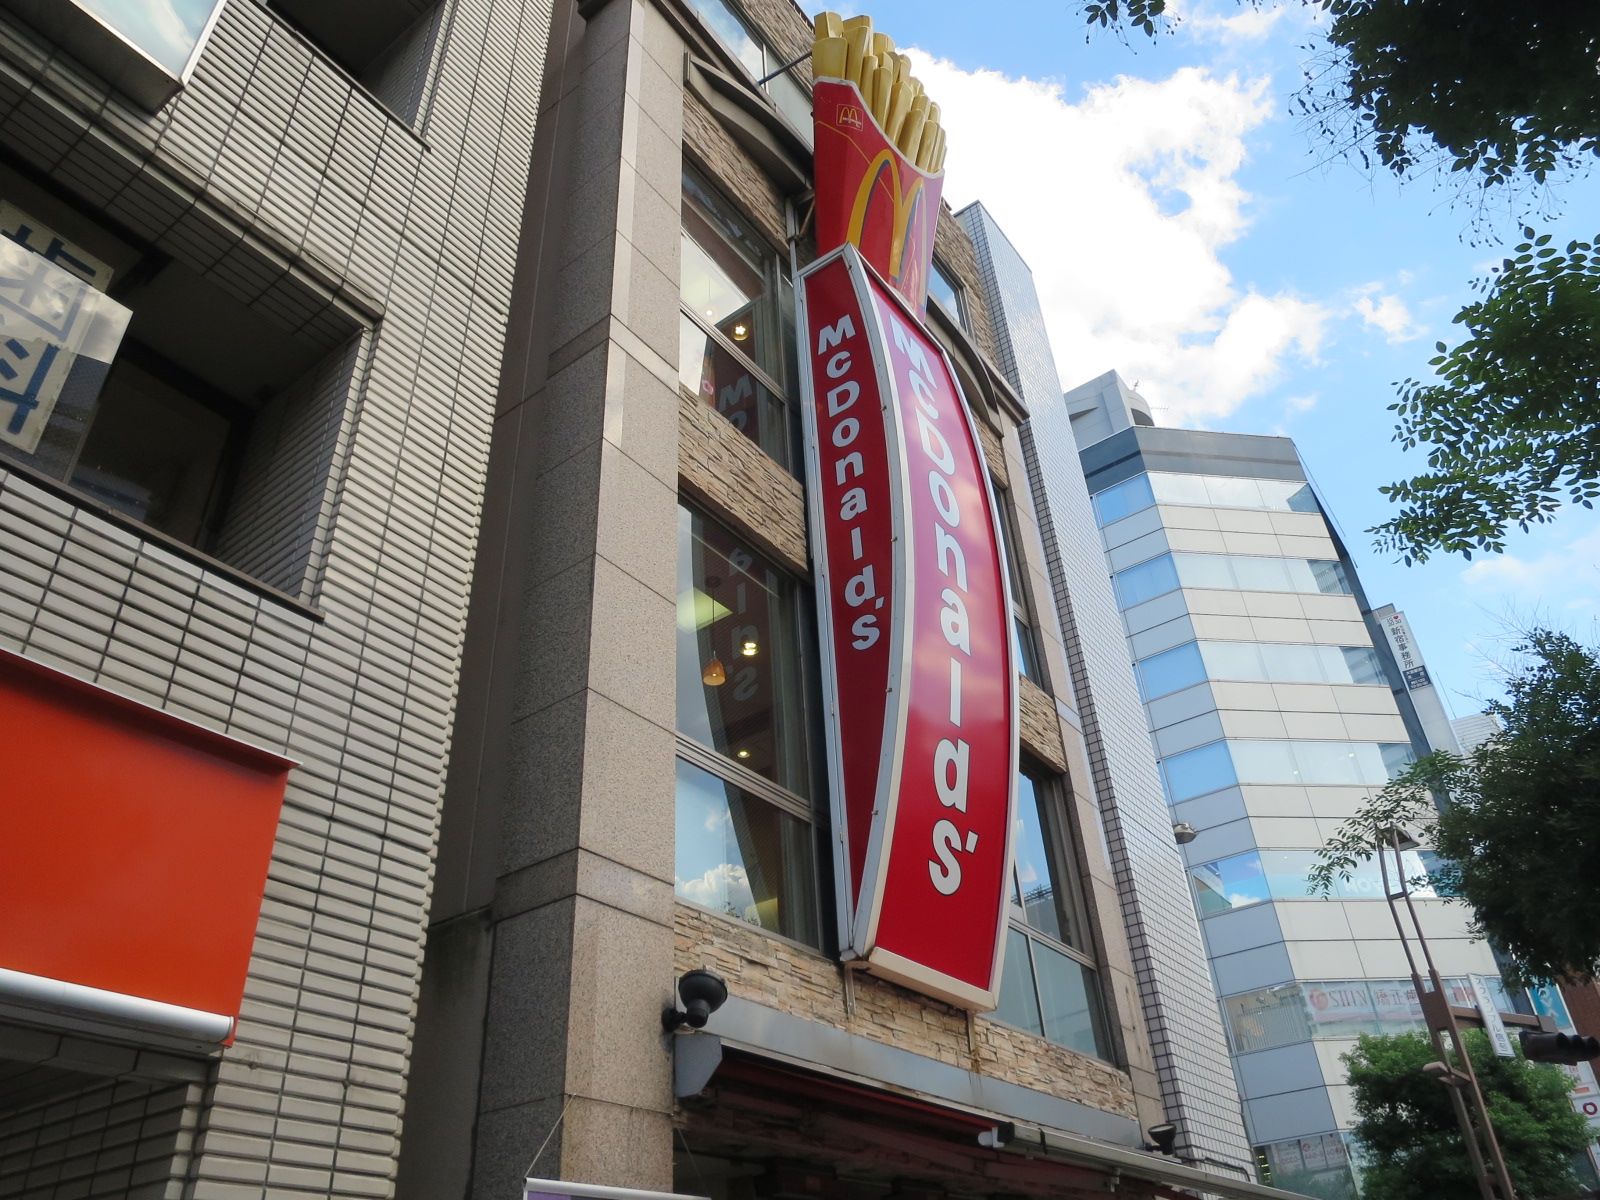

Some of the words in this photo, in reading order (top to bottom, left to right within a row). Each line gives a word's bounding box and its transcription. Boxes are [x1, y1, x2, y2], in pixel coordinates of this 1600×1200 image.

[817, 314, 886, 651] McDonald's
[890, 314, 979, 896] McDonald's
[1391, 626, 1415, 669] 新宿事務所
